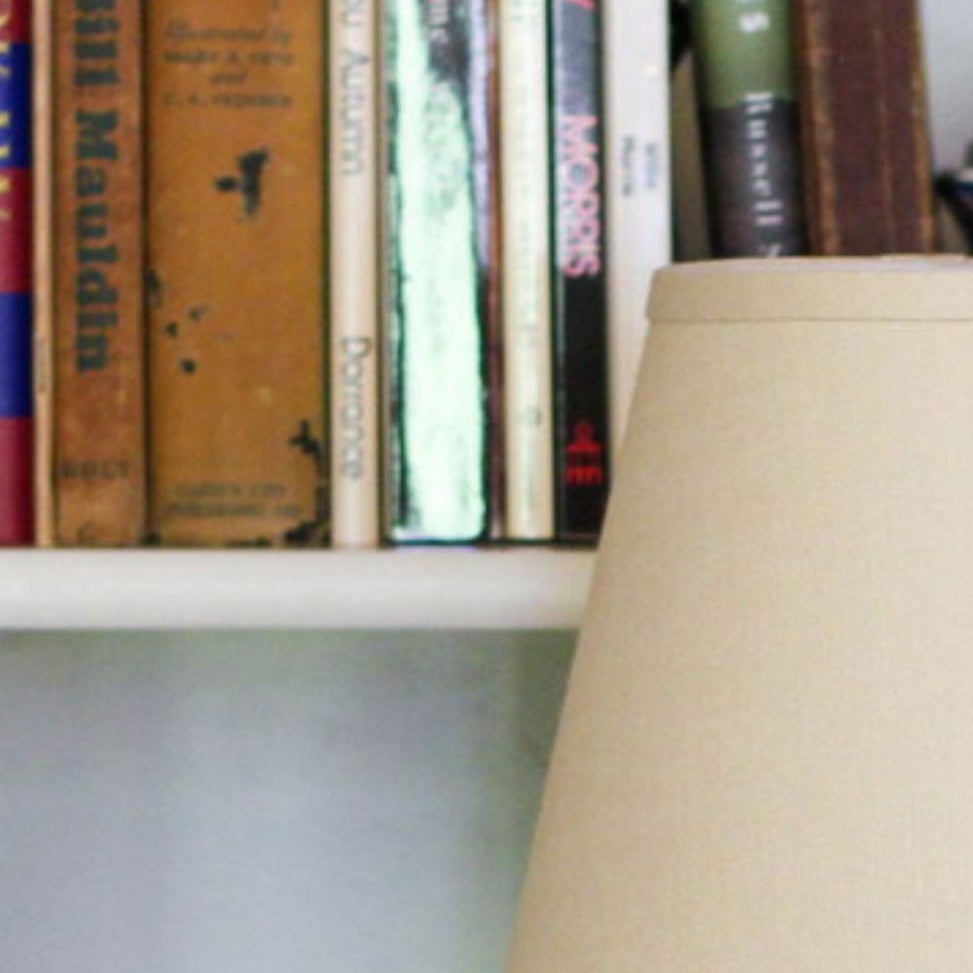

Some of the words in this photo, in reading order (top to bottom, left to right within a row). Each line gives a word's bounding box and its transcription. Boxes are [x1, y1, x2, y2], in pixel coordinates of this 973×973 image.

[341, 47, 371, 176] Autumn
[744, 91, 785, 226] Russell
[74, 110, 119, 372] Mauldin
[561, 114, 601, 277] MORRIS
[341, 336, 371, 480] Dorrance
